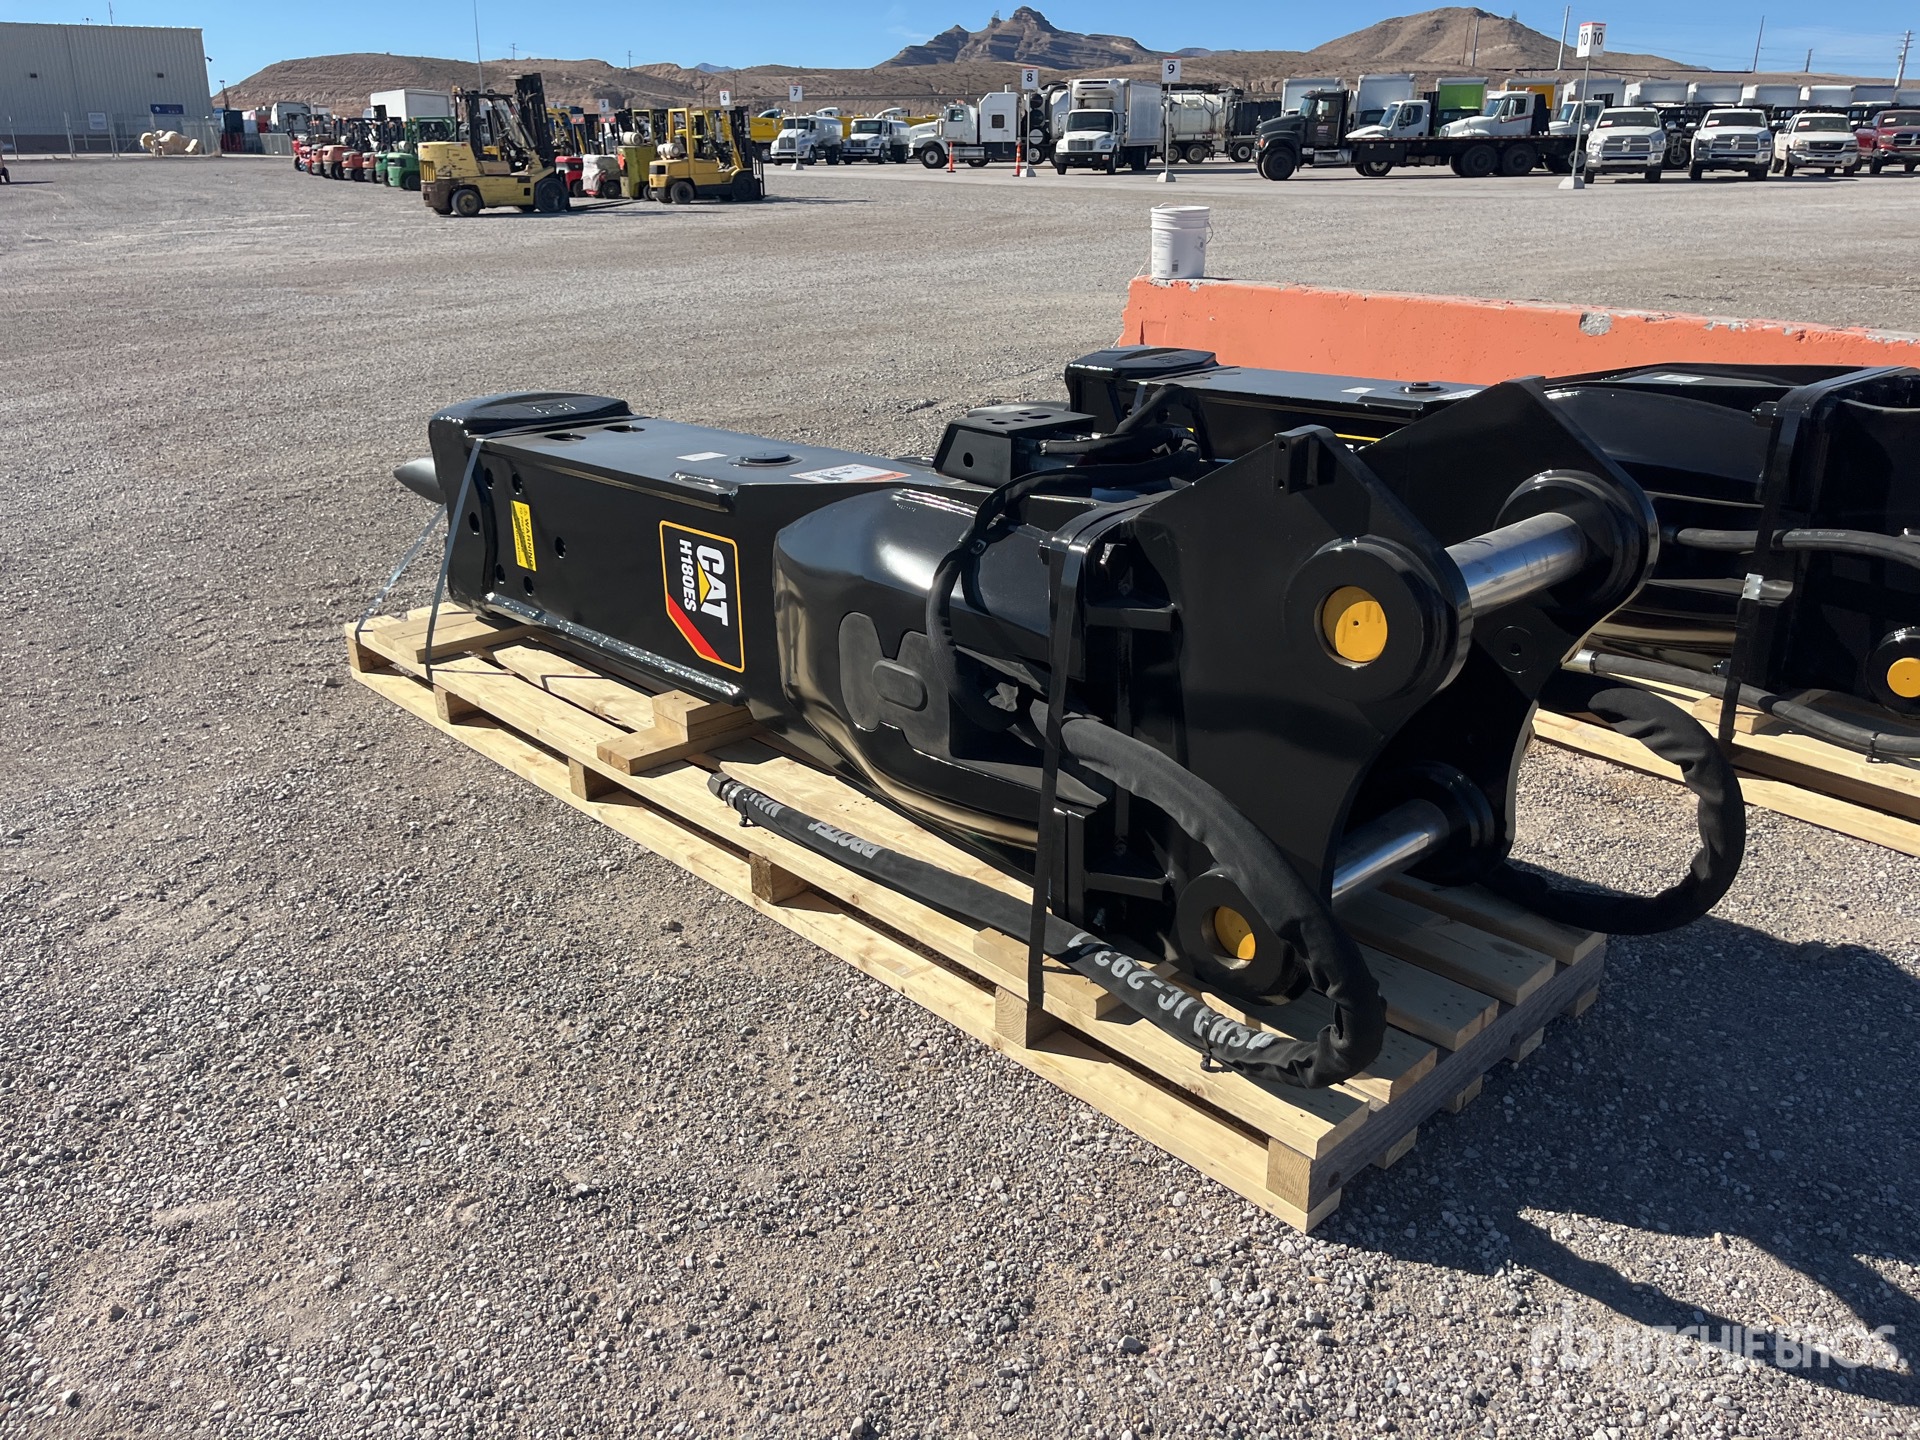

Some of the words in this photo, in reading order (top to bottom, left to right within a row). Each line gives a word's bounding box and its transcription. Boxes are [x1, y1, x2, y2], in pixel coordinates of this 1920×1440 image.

[1580, 32, 1589, 46] 10
[1593, 31, 1603, 46] 10
[1167, 63, 1175, 74] 9
[1026, 72, 1033, 82] 8
[793, 89, 799, 97] 7
[524, 518, 535, 568] WARNING
[679, 538, 697, 612] H180ES
[696, 544, 729, 627] CAT
